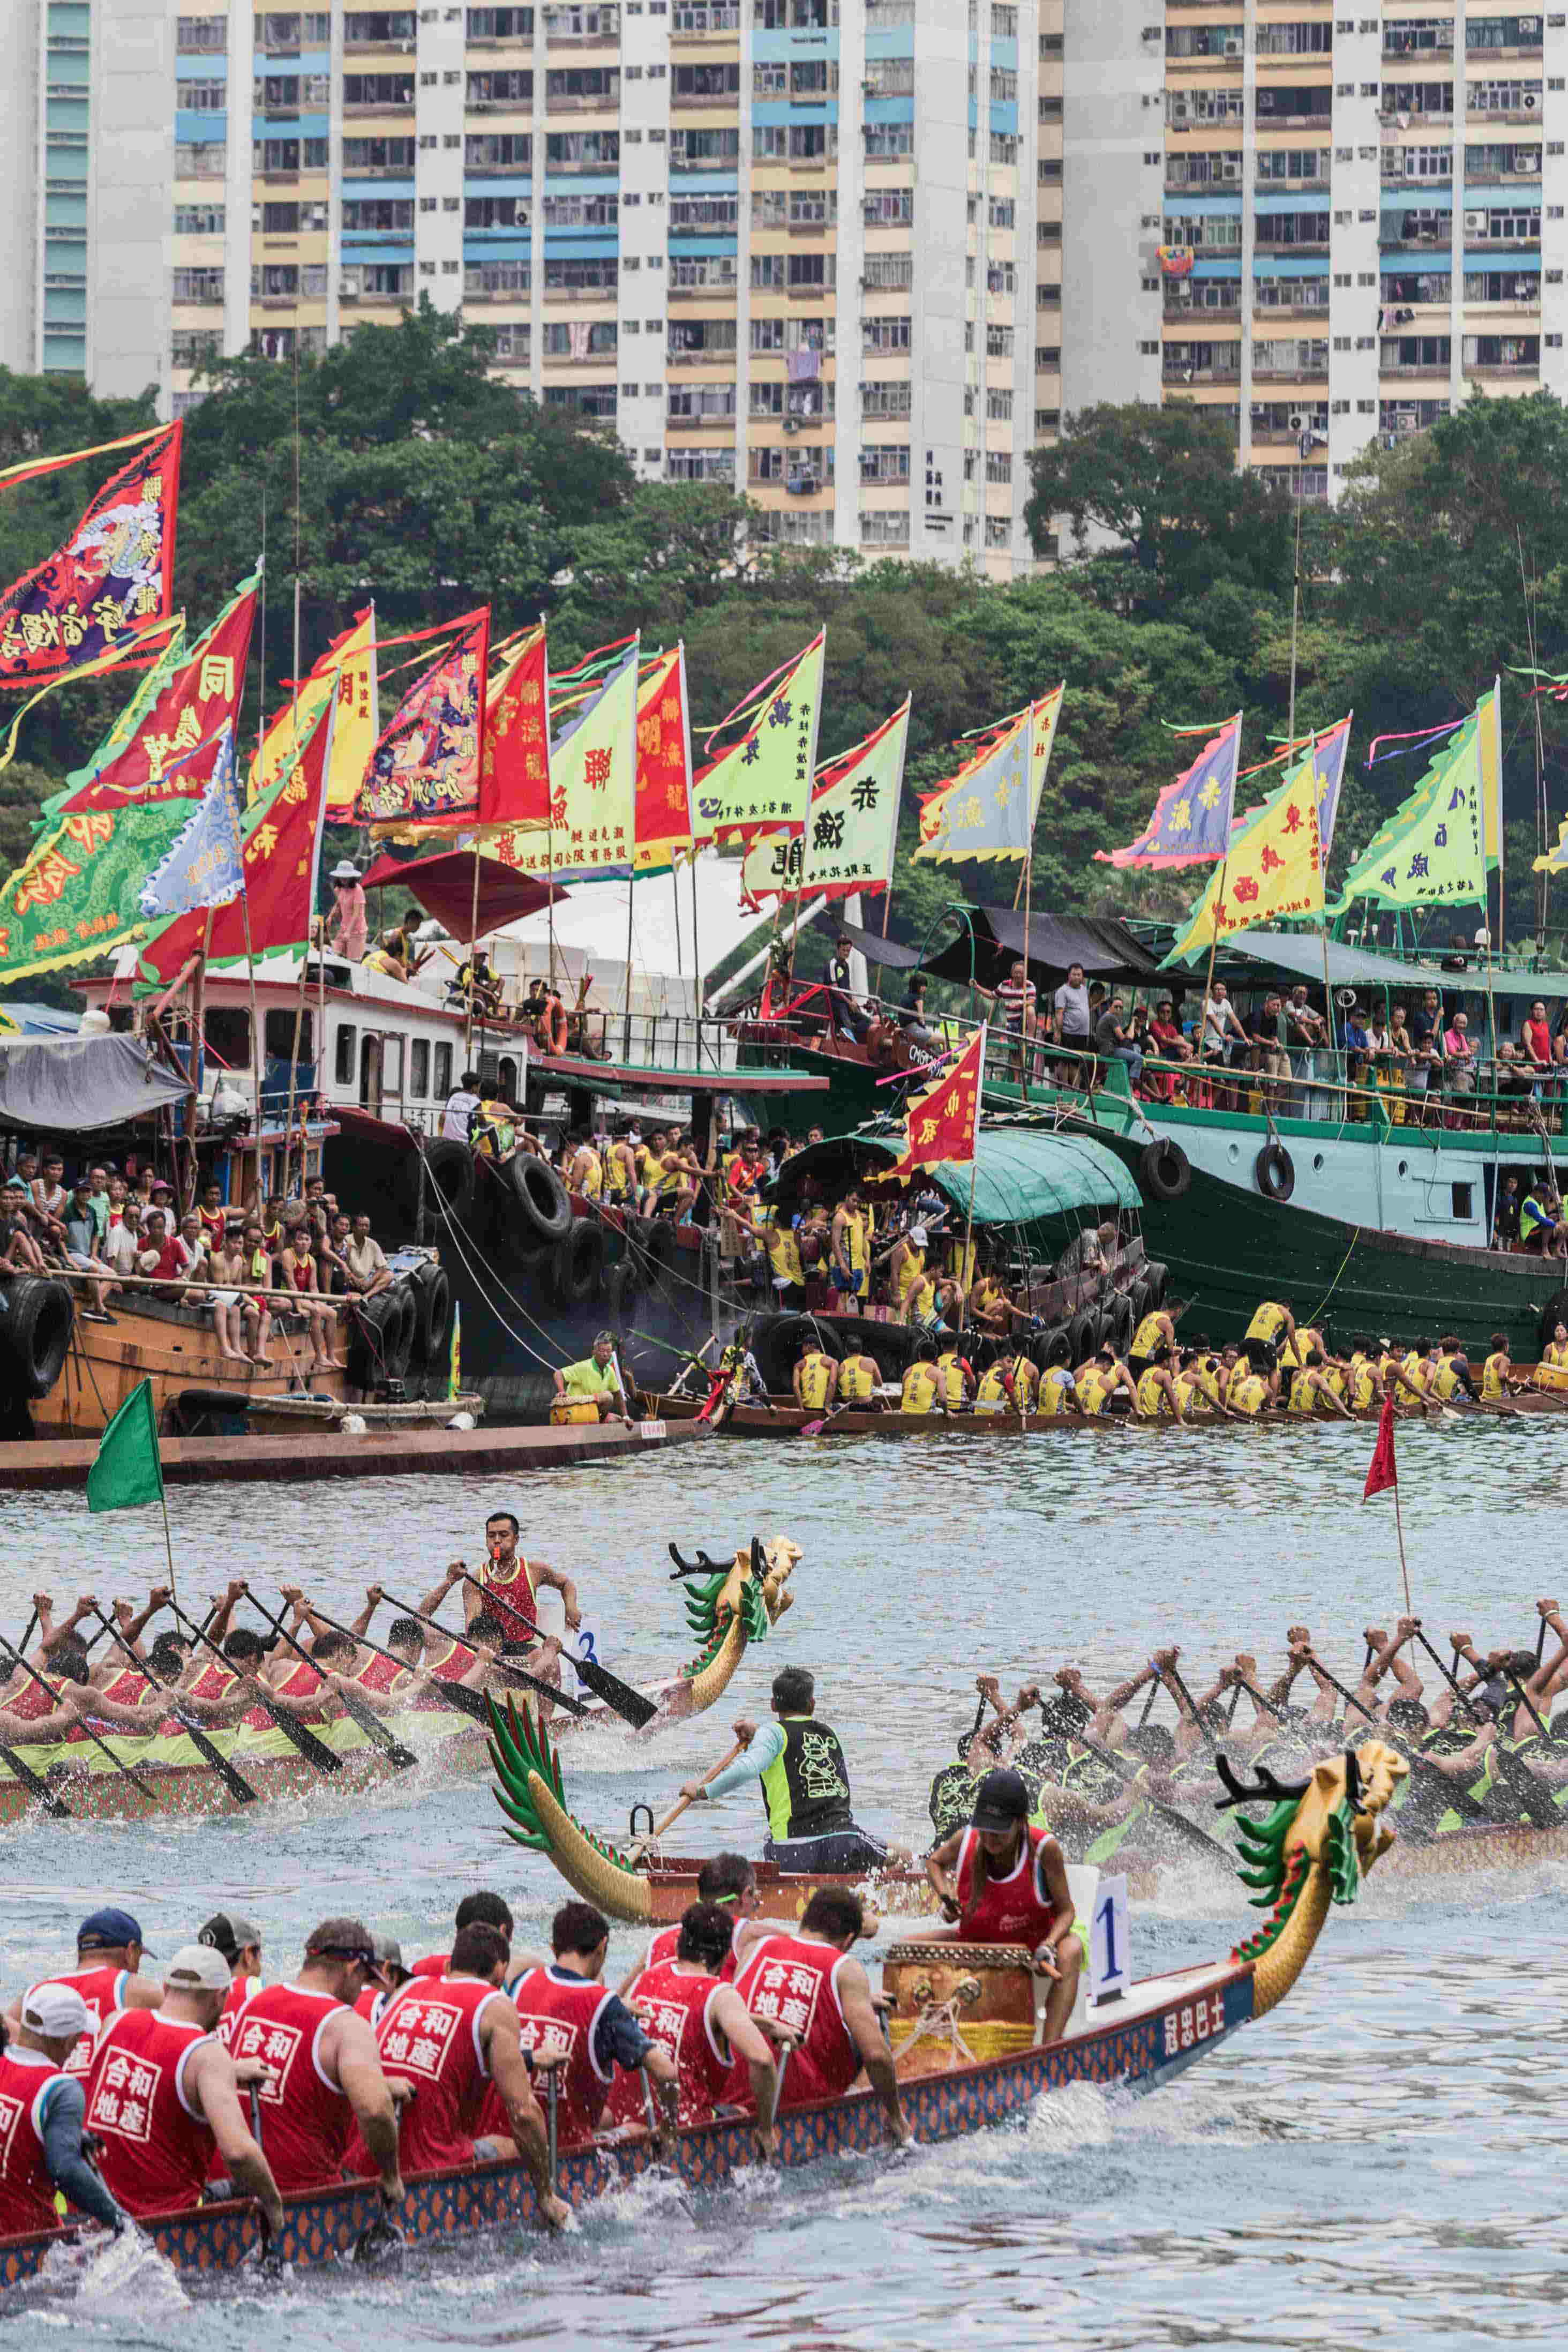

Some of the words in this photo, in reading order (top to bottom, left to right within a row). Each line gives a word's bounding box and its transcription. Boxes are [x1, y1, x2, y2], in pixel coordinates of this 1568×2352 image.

[578, 1631, 599, 1687] 3
[1096, 1896, 1123, 1981] 1
[763, 1965, 815, 1997] 合和
[397, 2006, 453, 2036] 合和
[754, 1990, 810, 2030] 地產
[242, 2024, 293, 2060] 合和
[382, 2032, 441, 2072] 地產
[106, 2056, 153, 2098] 合和
[94, 2090, 146, 2133] 地產
